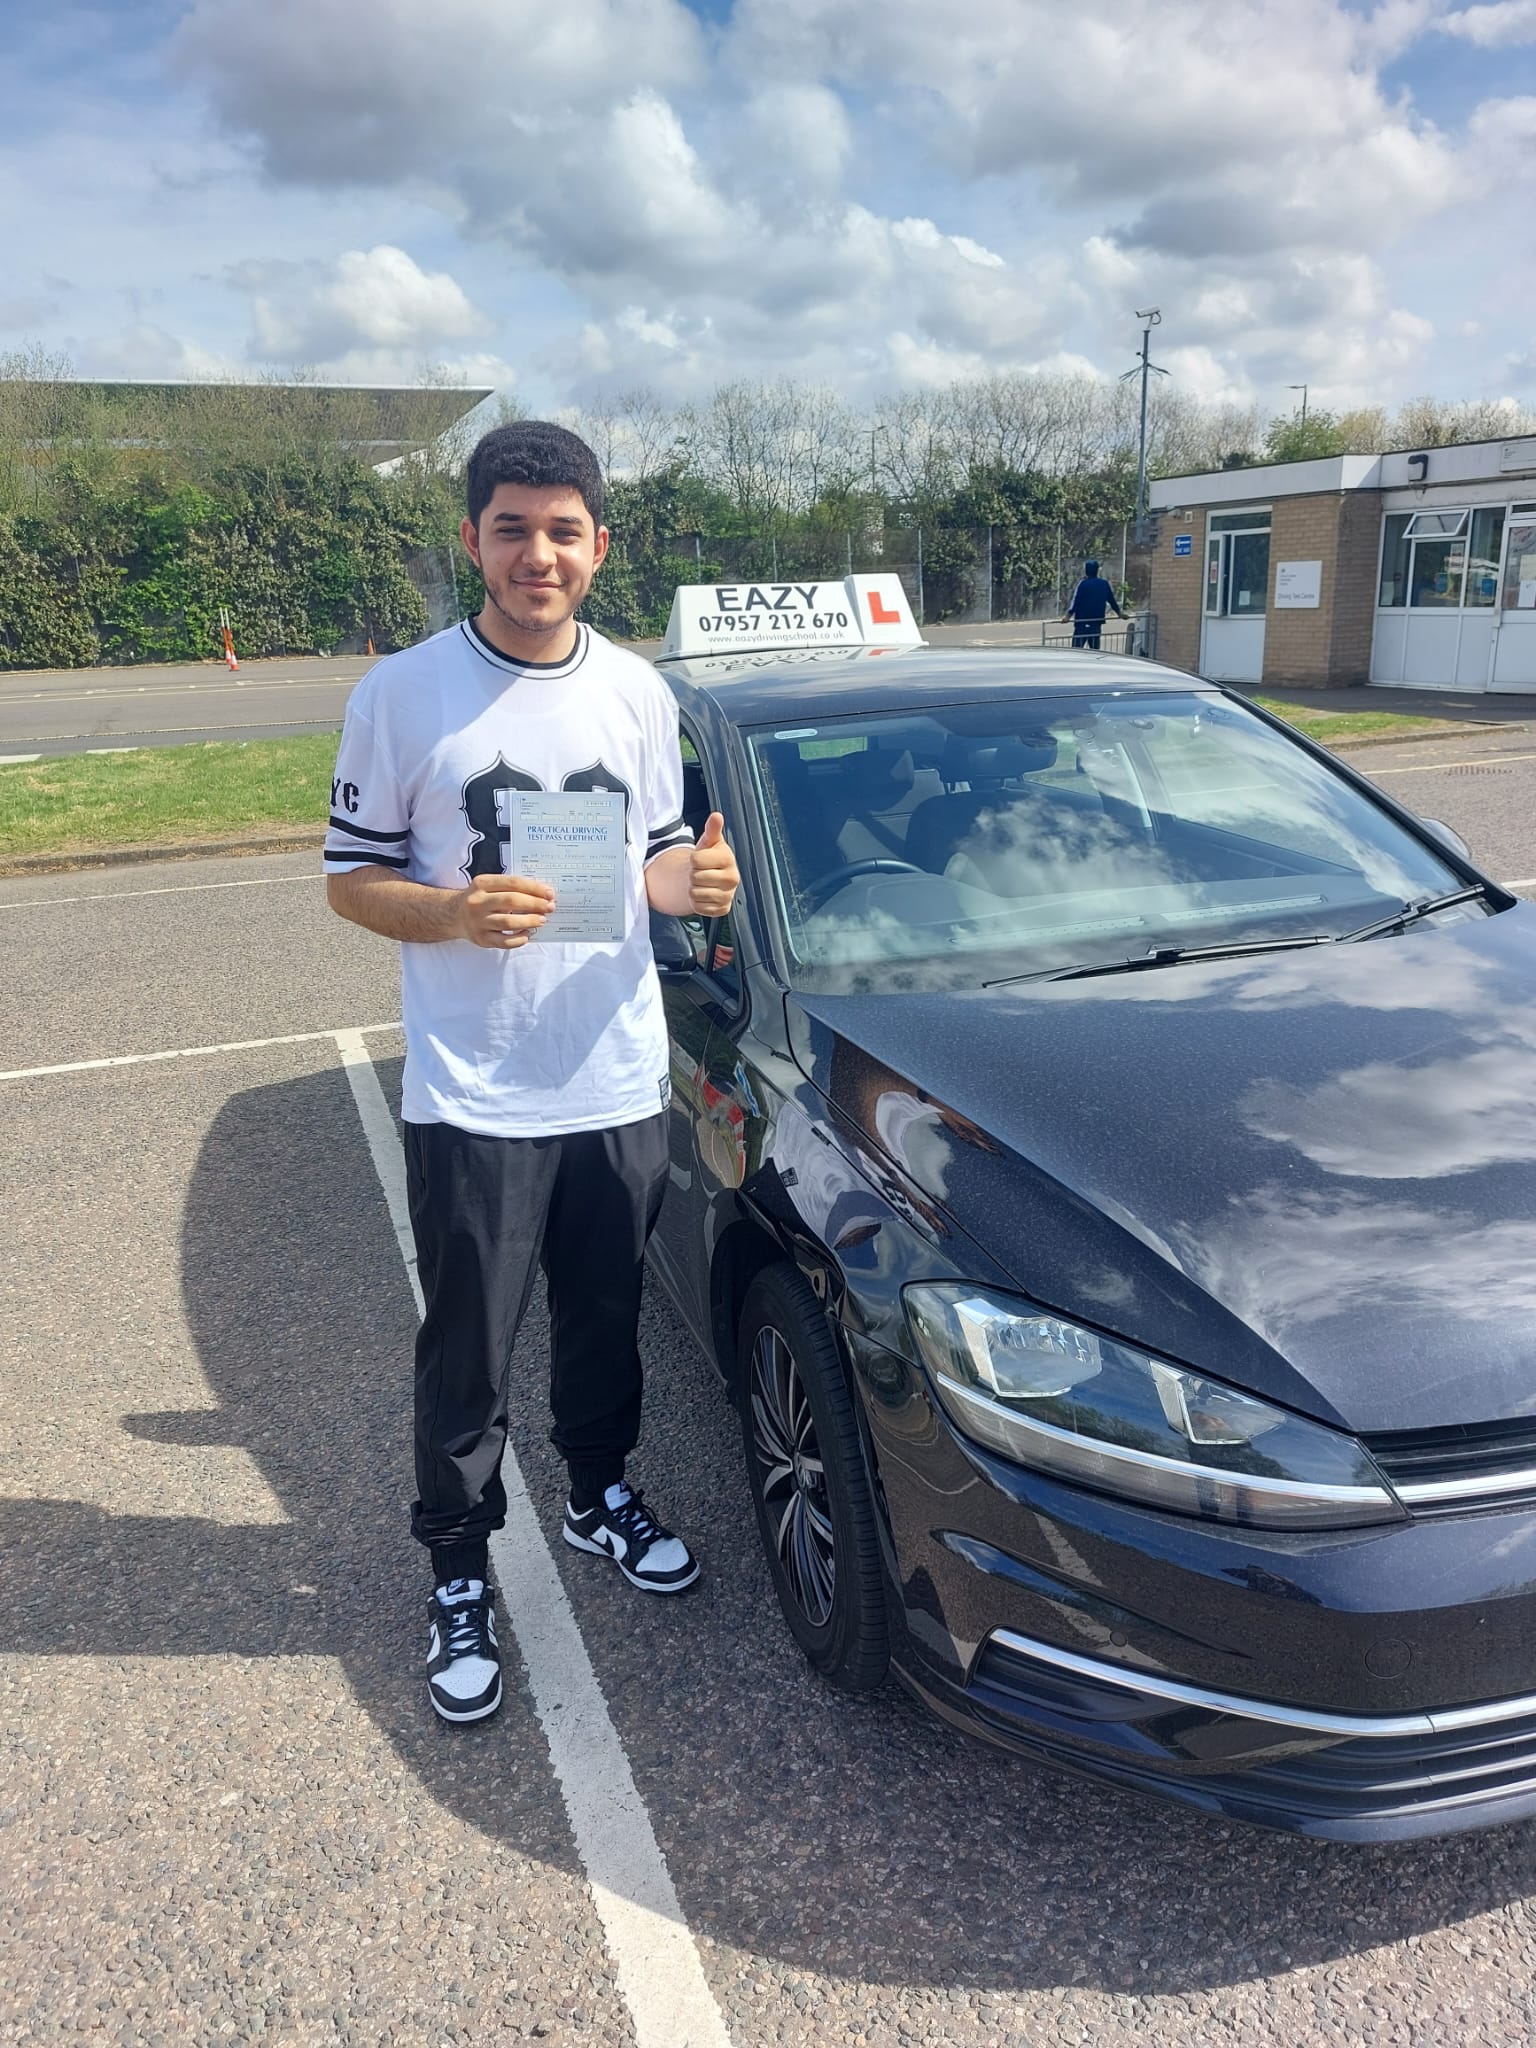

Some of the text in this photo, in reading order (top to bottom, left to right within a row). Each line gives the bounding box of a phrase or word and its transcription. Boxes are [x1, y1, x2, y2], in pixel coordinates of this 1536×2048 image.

[715, 586, 819, 612] EAZY
[867, 591, 902, 624] L
[699, 612, 848, 632] 07957 212 670
[527, 825, 608, 835] PRACTICAL DRIVING
